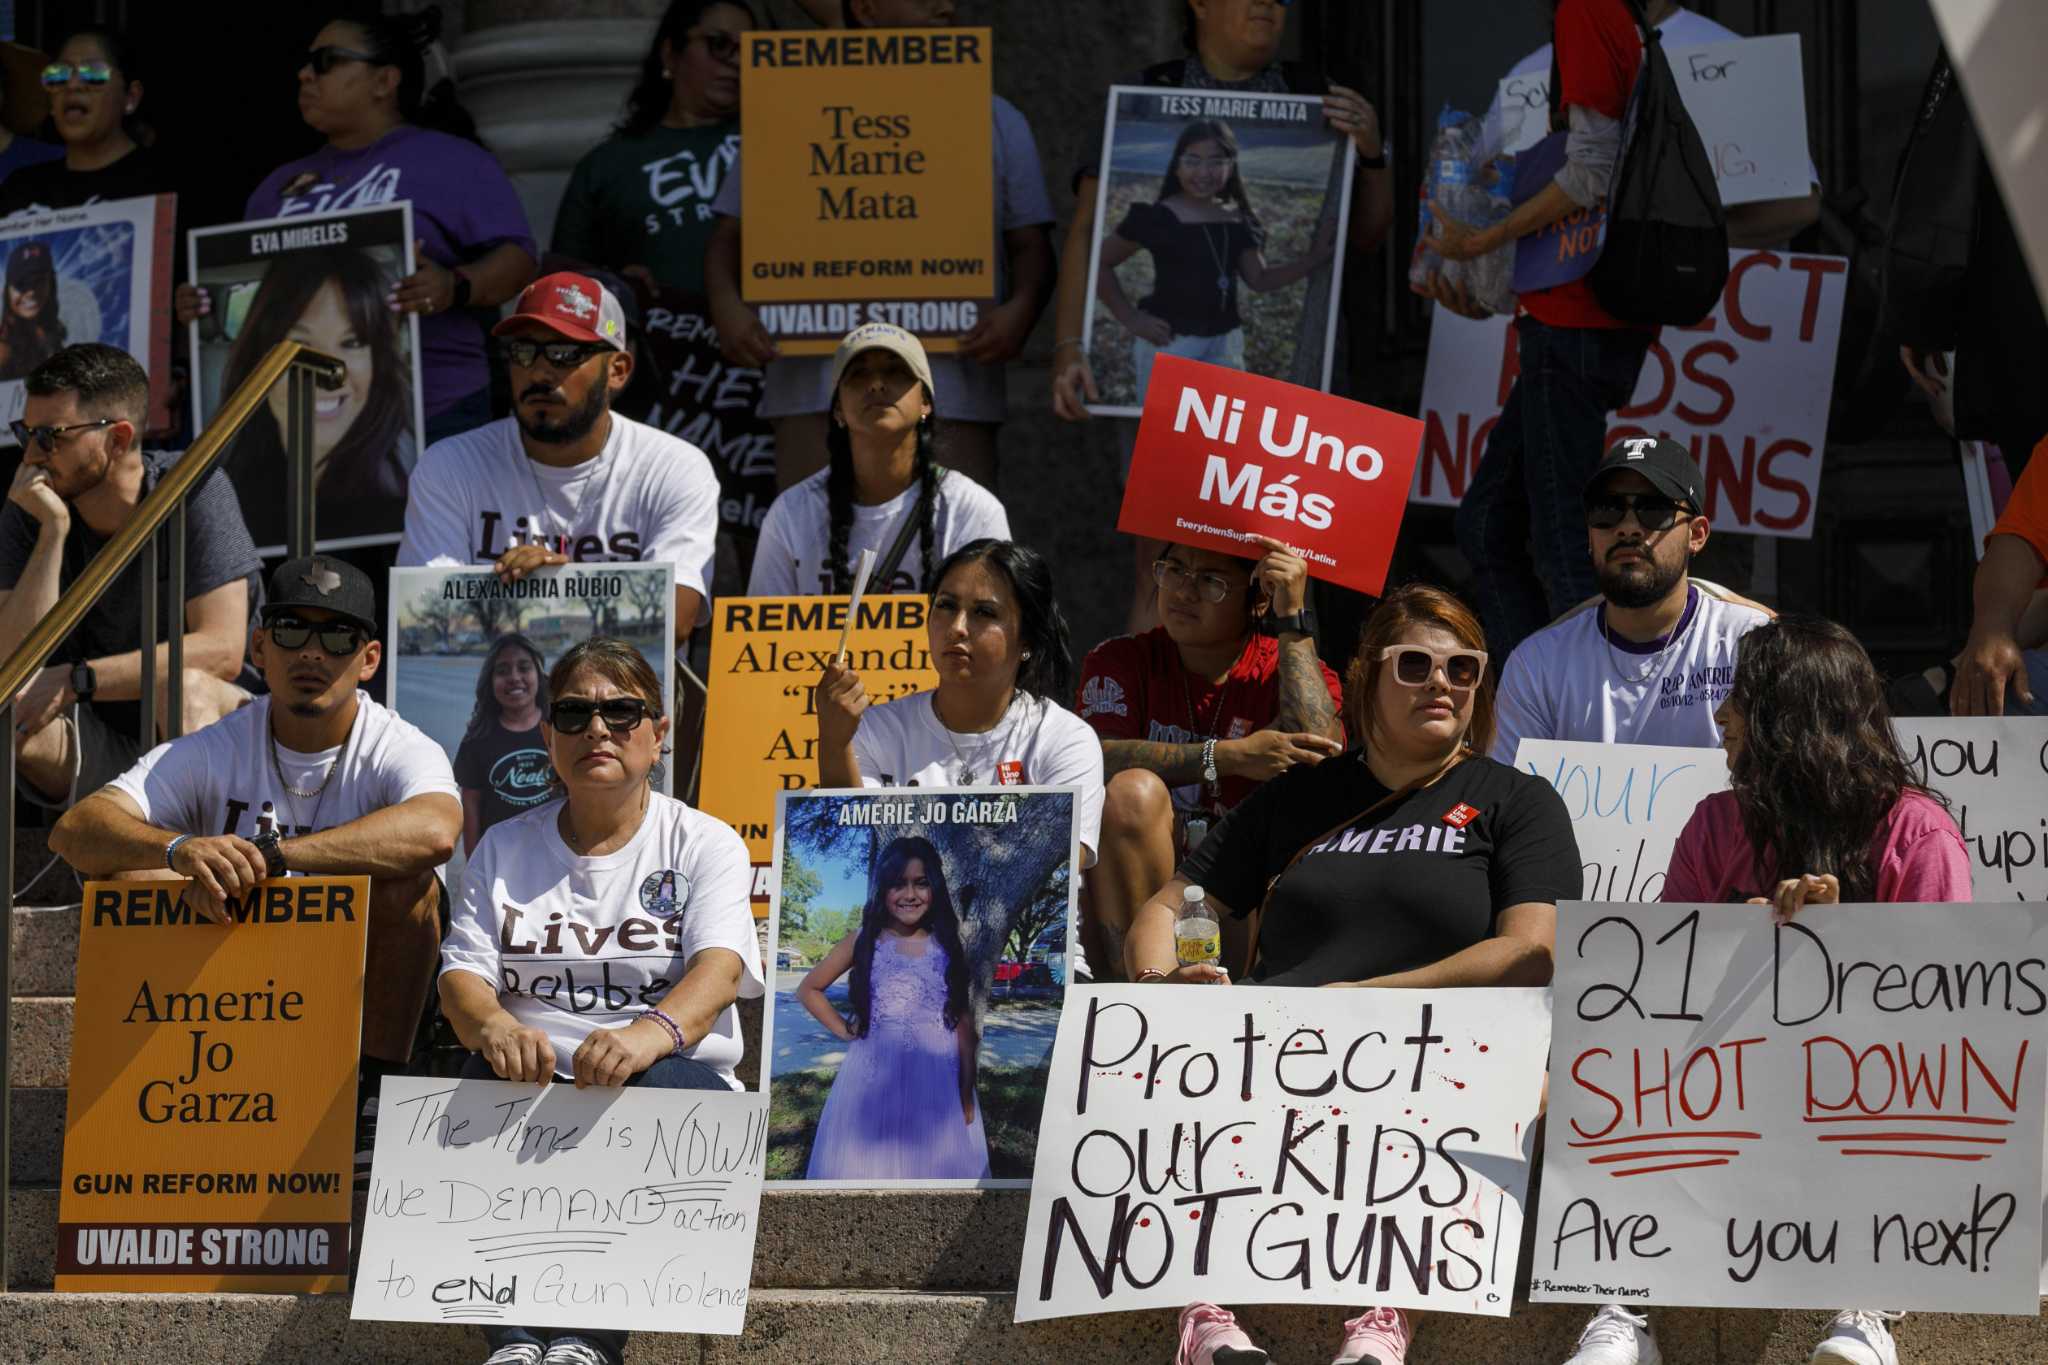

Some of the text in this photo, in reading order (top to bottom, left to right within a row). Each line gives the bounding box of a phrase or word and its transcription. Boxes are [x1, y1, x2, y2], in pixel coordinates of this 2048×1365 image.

[752, 35, 982, 67] REMEMBER
[1688, 53, 1736, 82] For
[822, 106, 911, 139] Tess
[1160, 95, 1307, 121] TESS MARIE MATA
[809, 142, 926, 175] Marie
[817, 186, 919, 220] Mata
[251, 222, 348, 254] EVA MIRELES
[752, 258, 984, 278] GUN REFORM NOW!
[759, 301, 978, 334] UVALDE STRONG
[1703, 250, 1846, 342] CT
[646, 306, 720, 349] REM
[669, 354, 767, 409] HE
[1174, 386, 1384, 481] Ni Uno
[1624, 438, 1657, 460] T
[1199, 454, 1335, 530] Más
[443, 576, 621, 600] ALEXANDRIA RUBIO
[726, 601, 924, 632] REMEMB
[1661, 672, 1684, 695] RIP
[839, 802, 1018, 825] AMERIE JO GARZA
[93, 885, 356, 927] REMMBER
[502, 903, 683, 956] Lives
[1576, 909, 2048, 1027] 21 Dreams
[122, 979, 304, 1023] Amerie
[178, 1030, 233, 1085] Jo
[1076, 996, 1444, 1116] Protect
[138, 1080, 277, 1124] Garza
[1569, 1035, 2029, 1139] SHOT DOWN
[396, 1088, 472, 1149] The
[491, 1096, 578, 1153] Time
[606, 1117, 632, 1149] is
[1071, 1108, 1480, 1208] our KIDS
[73, 1172, 340, 1195] GUN REFORM NOW!
[372, 1178, 747, 1234] We DEMAND action
[76, 1228, 329, 1266] UVALDE STRONG
[1039, 1186, 1503, 1303] NOT GUNS!
[1553, 1183, 2017, 1282] Are you next?
[377, 1258, 415, 1299] to
[532, 1263, 629, 1308] Gun
[642, 1253, 749, 1309] Violence
